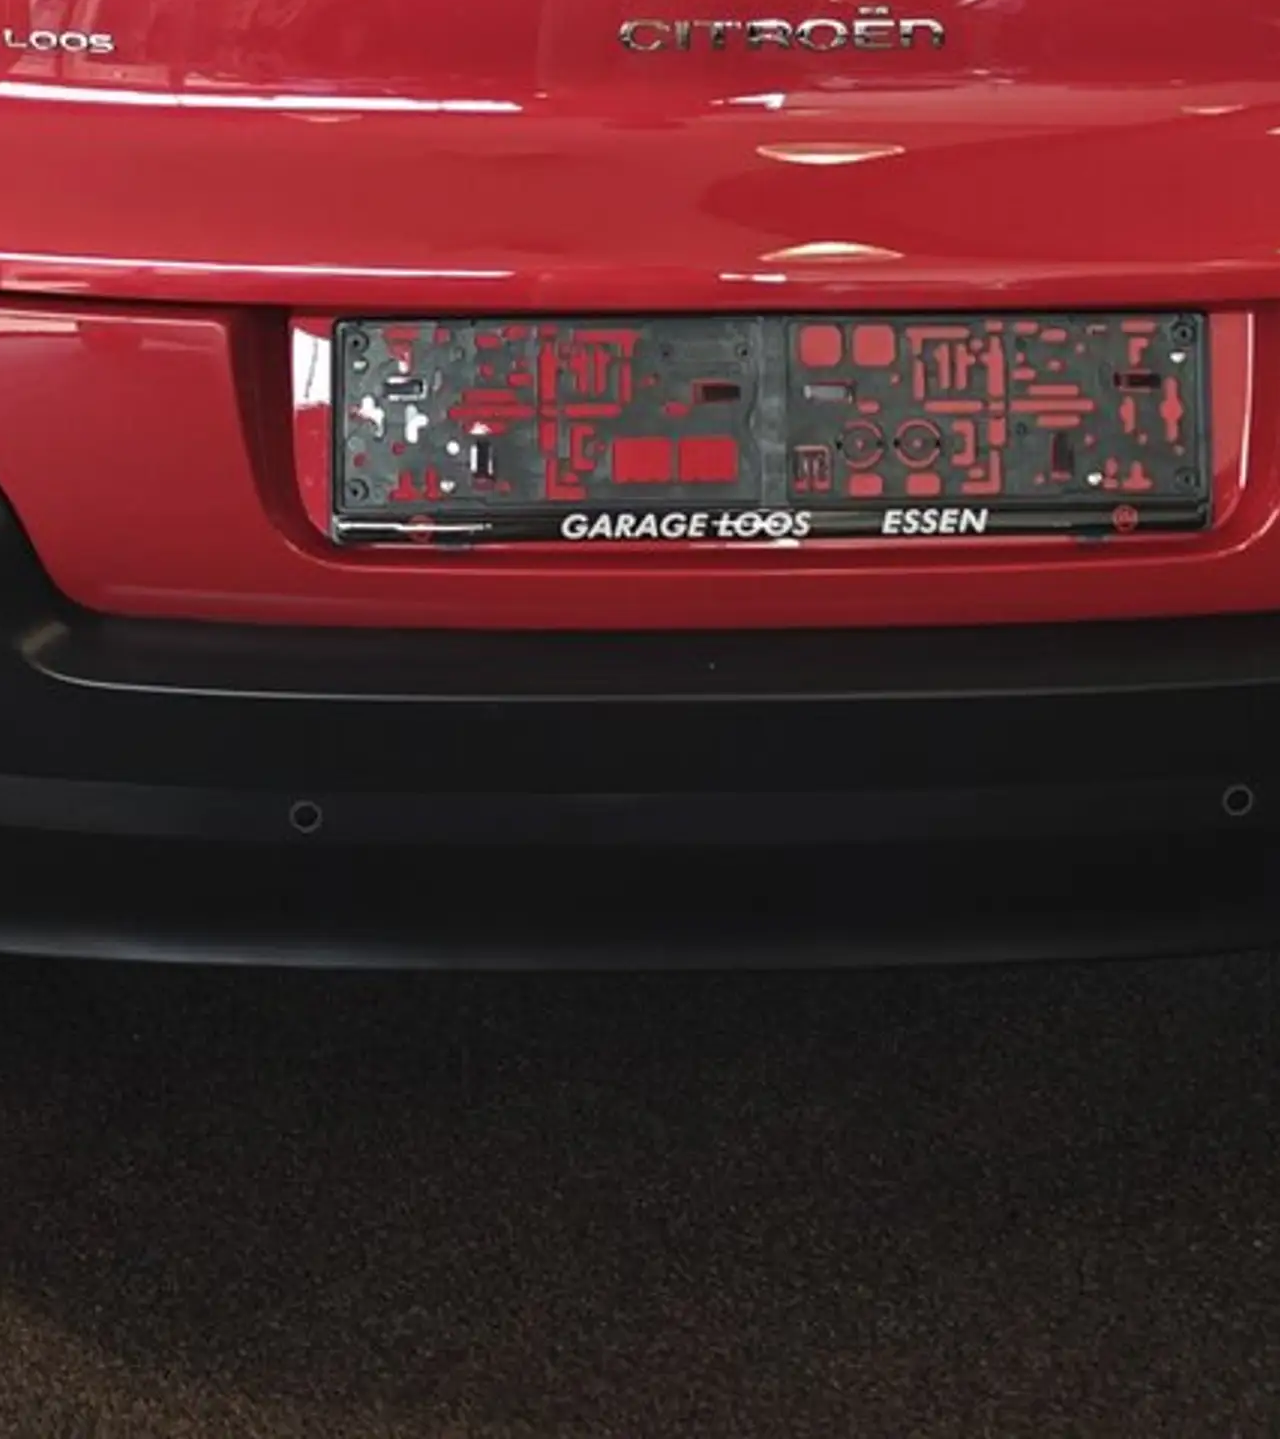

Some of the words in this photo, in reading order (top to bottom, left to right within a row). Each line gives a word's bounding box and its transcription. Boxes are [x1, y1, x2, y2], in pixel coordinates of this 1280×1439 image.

[2, 27, 115, 54] LOOS
[560, 511, 710, 539] GARAGE
[716, 510, 812, 538] LOOS
[881, 507, 989, 534] ESSEN
